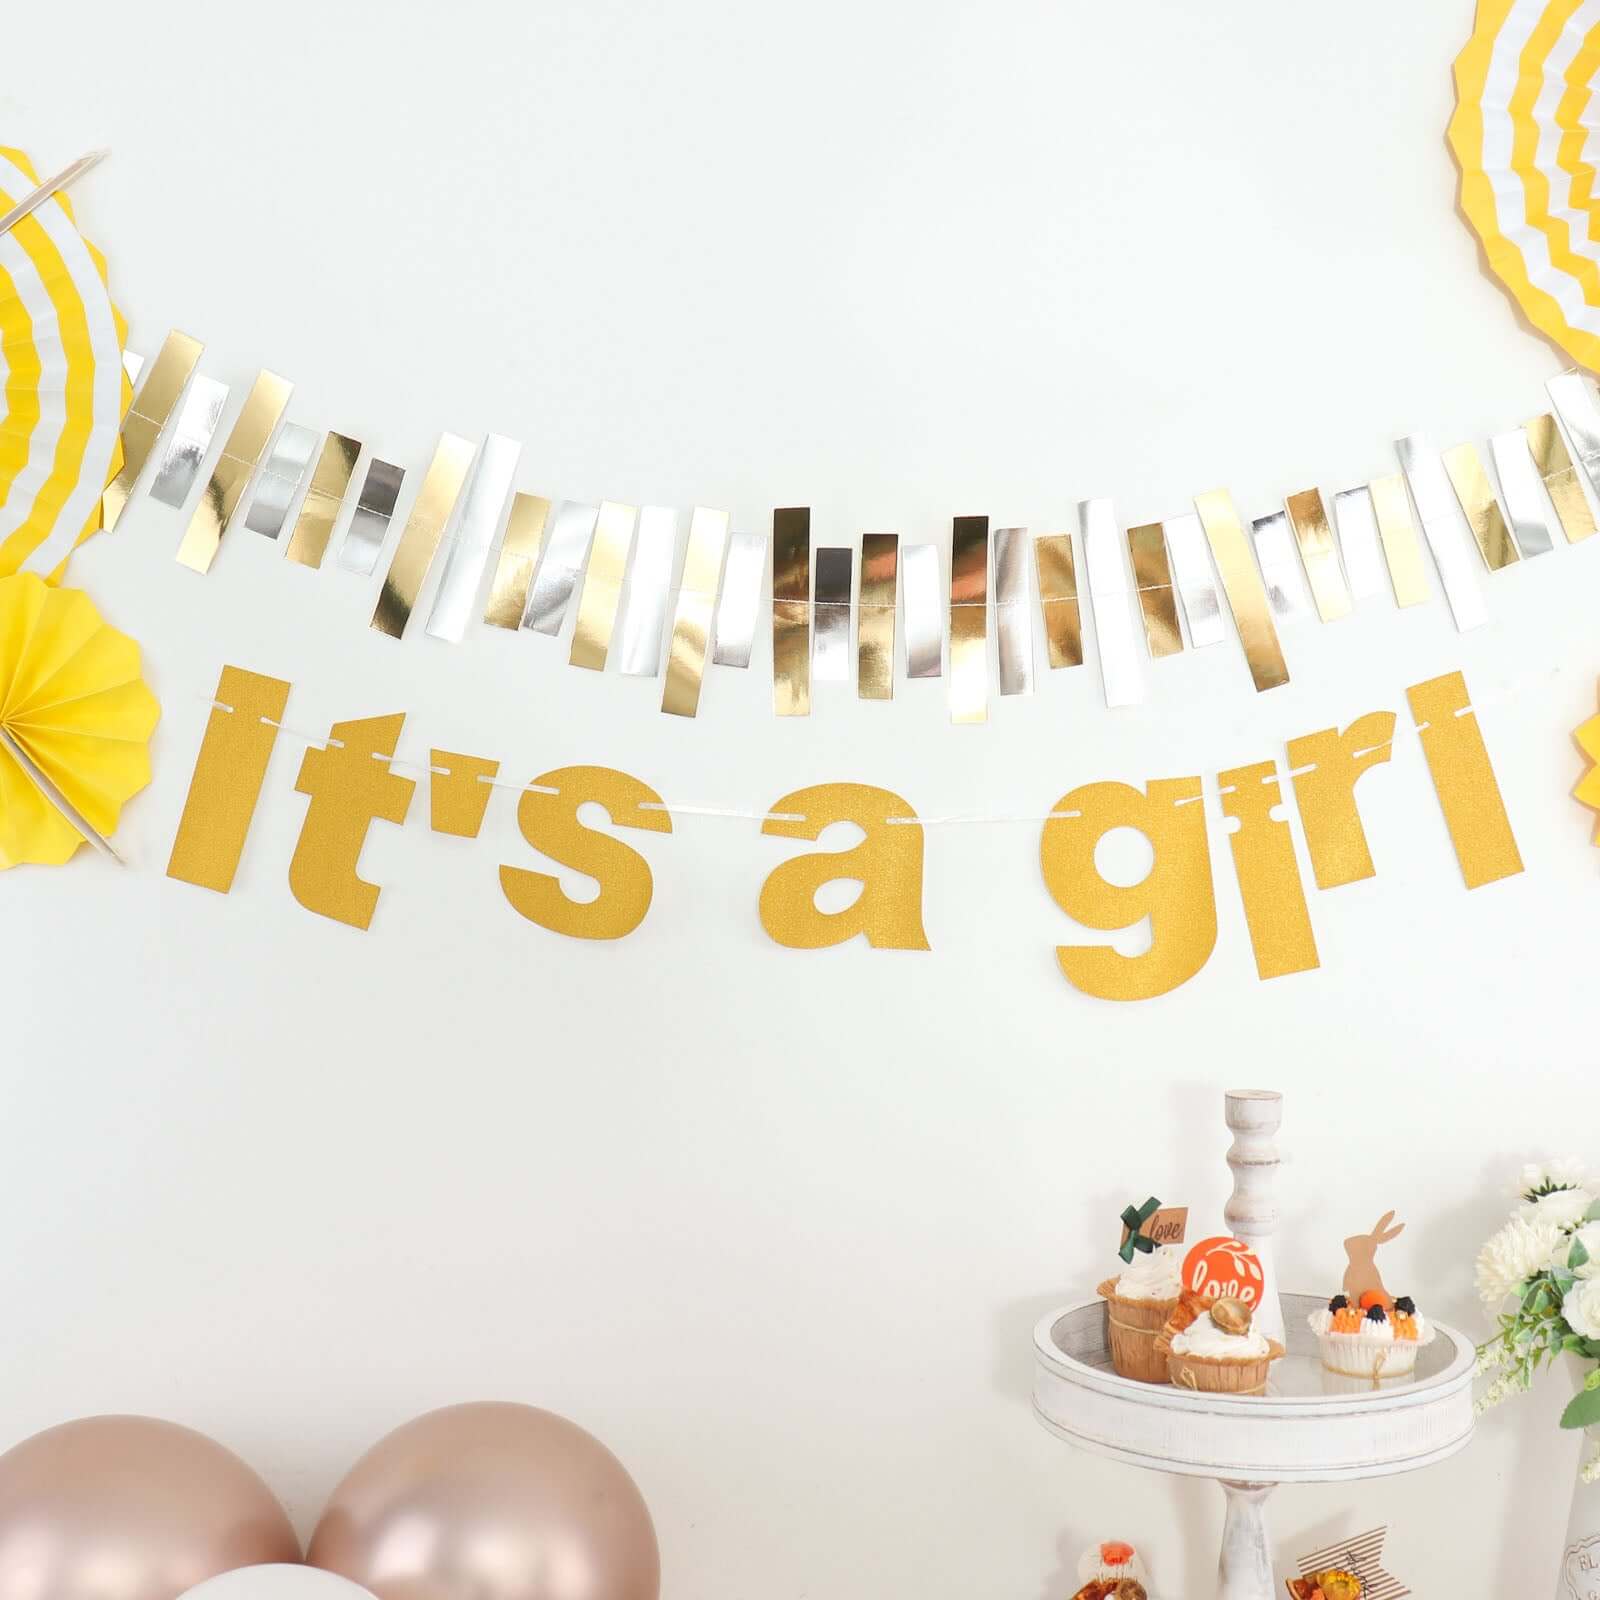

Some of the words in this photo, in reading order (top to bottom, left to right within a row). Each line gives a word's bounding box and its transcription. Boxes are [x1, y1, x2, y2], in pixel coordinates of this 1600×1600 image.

[168, 665, 674, 940] It's
[759, 783, 931, 951] a
[1040, 671, 1523, 1002] girl
[1150, 1213, 1181, 1241] love
